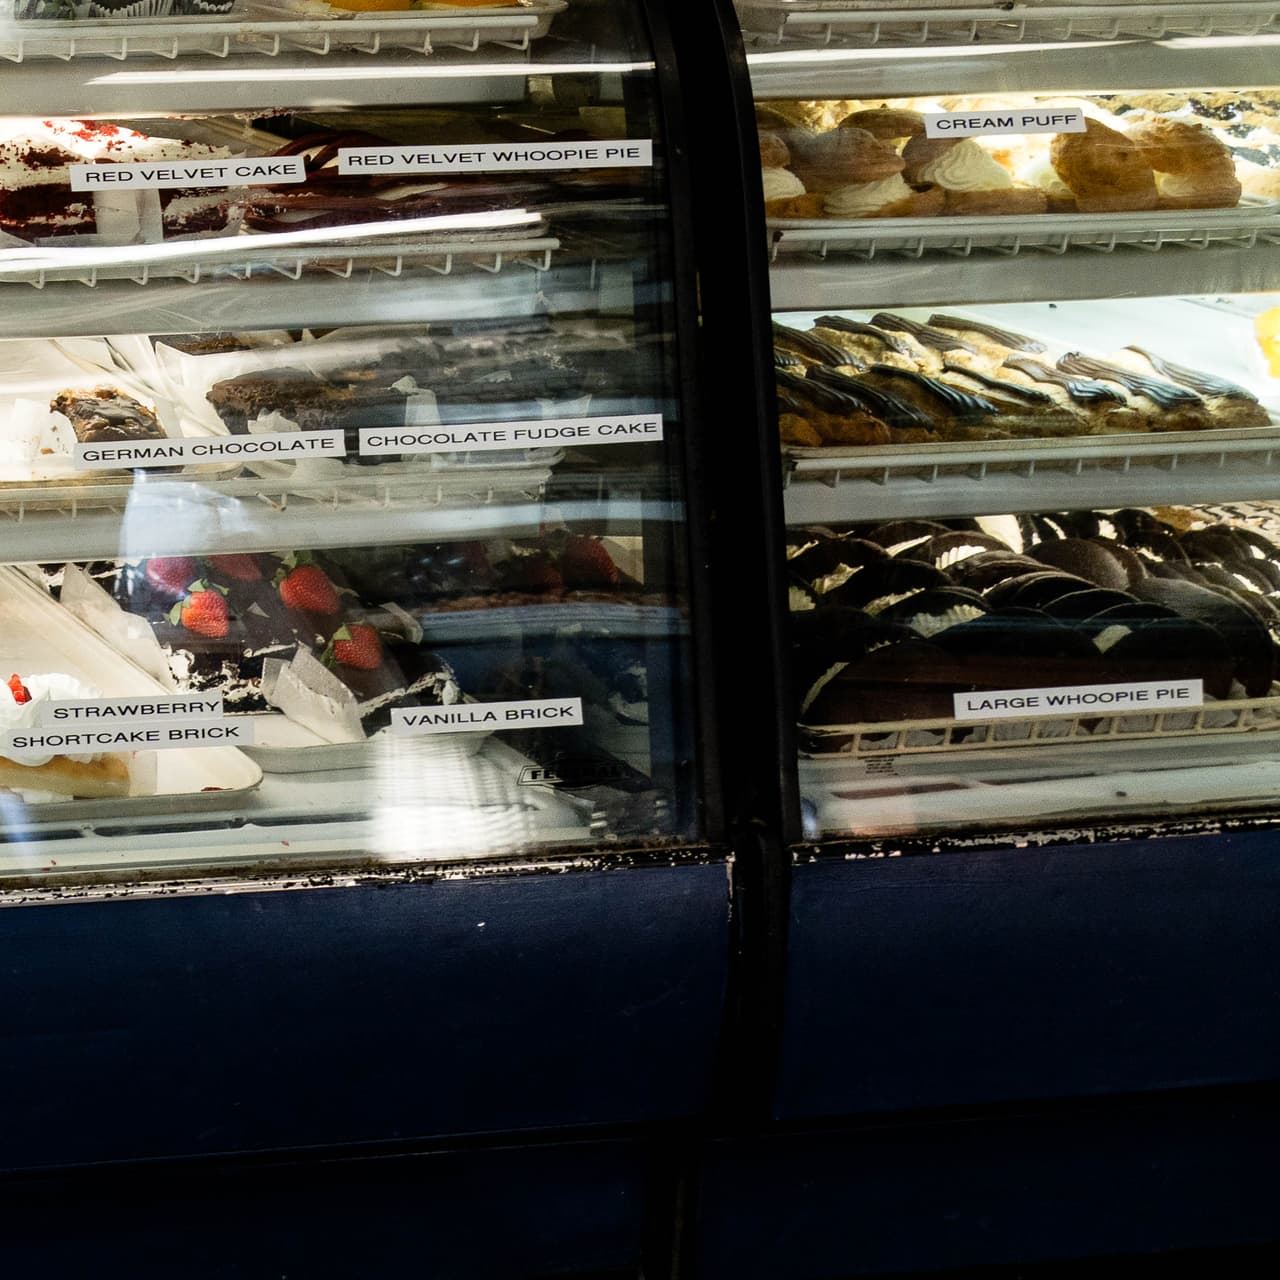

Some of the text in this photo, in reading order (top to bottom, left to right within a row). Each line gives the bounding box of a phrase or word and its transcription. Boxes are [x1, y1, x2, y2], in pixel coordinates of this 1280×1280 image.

[936, 114, 1077, 130] CREAM PUFF
[348, 147, 640, 167] RED VELVET WHOOPIE PIE
[84, 163, 297, 183] RED VELVET CAKE
[367, 422, 657, 447] CHOCOLATE FUDGE CAKE
[82, 438, 334, 462] GERMAN CHOCOLATE
[967, 687, 1190, 711] LARGE WHOOPIE PIE
[53, 701, 220, 719] STRAWBERRY
[402, 706, 574, 726] VANILLA BRICK
[12, 726, 240, 748] SHORTCAKE BRICK
